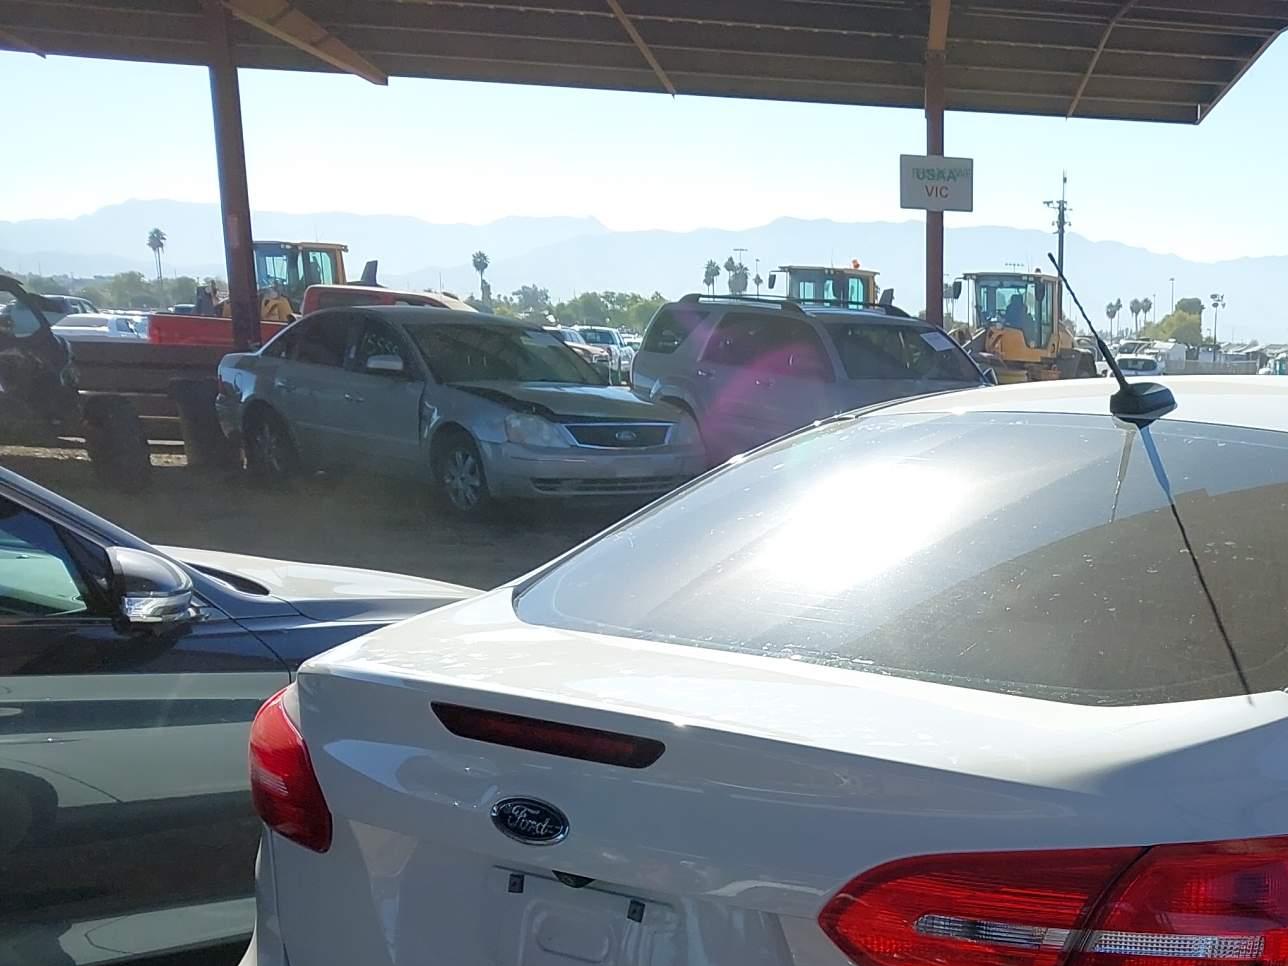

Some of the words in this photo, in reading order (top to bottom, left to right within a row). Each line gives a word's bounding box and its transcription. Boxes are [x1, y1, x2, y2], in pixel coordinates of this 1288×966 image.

[915, 167, 957, 181] USAA
[925, 185, 949, 198] VIC
[507, 804, 554, 835] Ford
